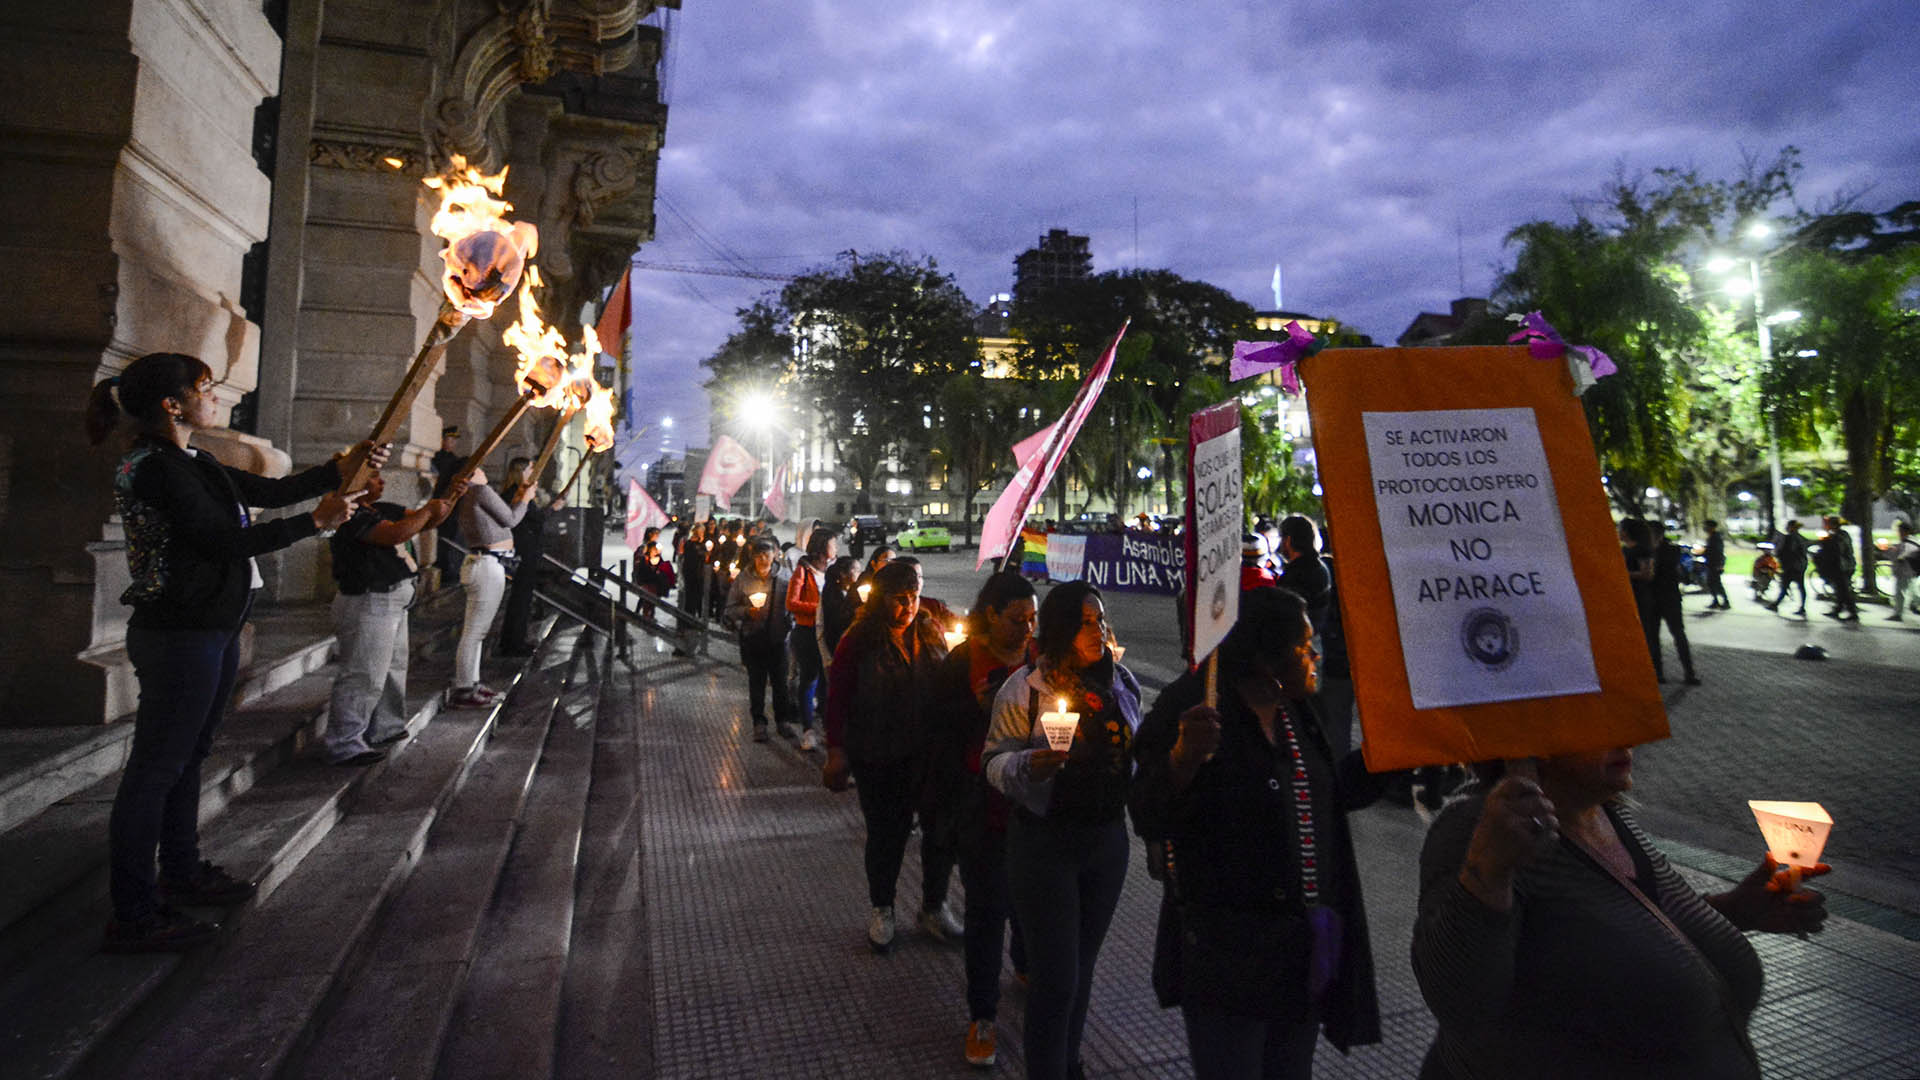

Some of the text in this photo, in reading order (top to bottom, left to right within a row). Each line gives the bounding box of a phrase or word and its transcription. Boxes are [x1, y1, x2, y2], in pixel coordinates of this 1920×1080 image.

[1385, 427, 1508, 445] SE ACTIVARON
[1402, 449, 1498, 468] TODOS LOS
[1197, 468, 1238, 521] SOLAS
[1378, 473, 1538, 495] PROTOCOLOS PERO
[1408, 499, 1520, 527] MONICA
[1450, 538, 1492, 561] NO
[1087, 561, 1187, 590] NI UNA M
[1418, 571, 1546, 602] APARACE
